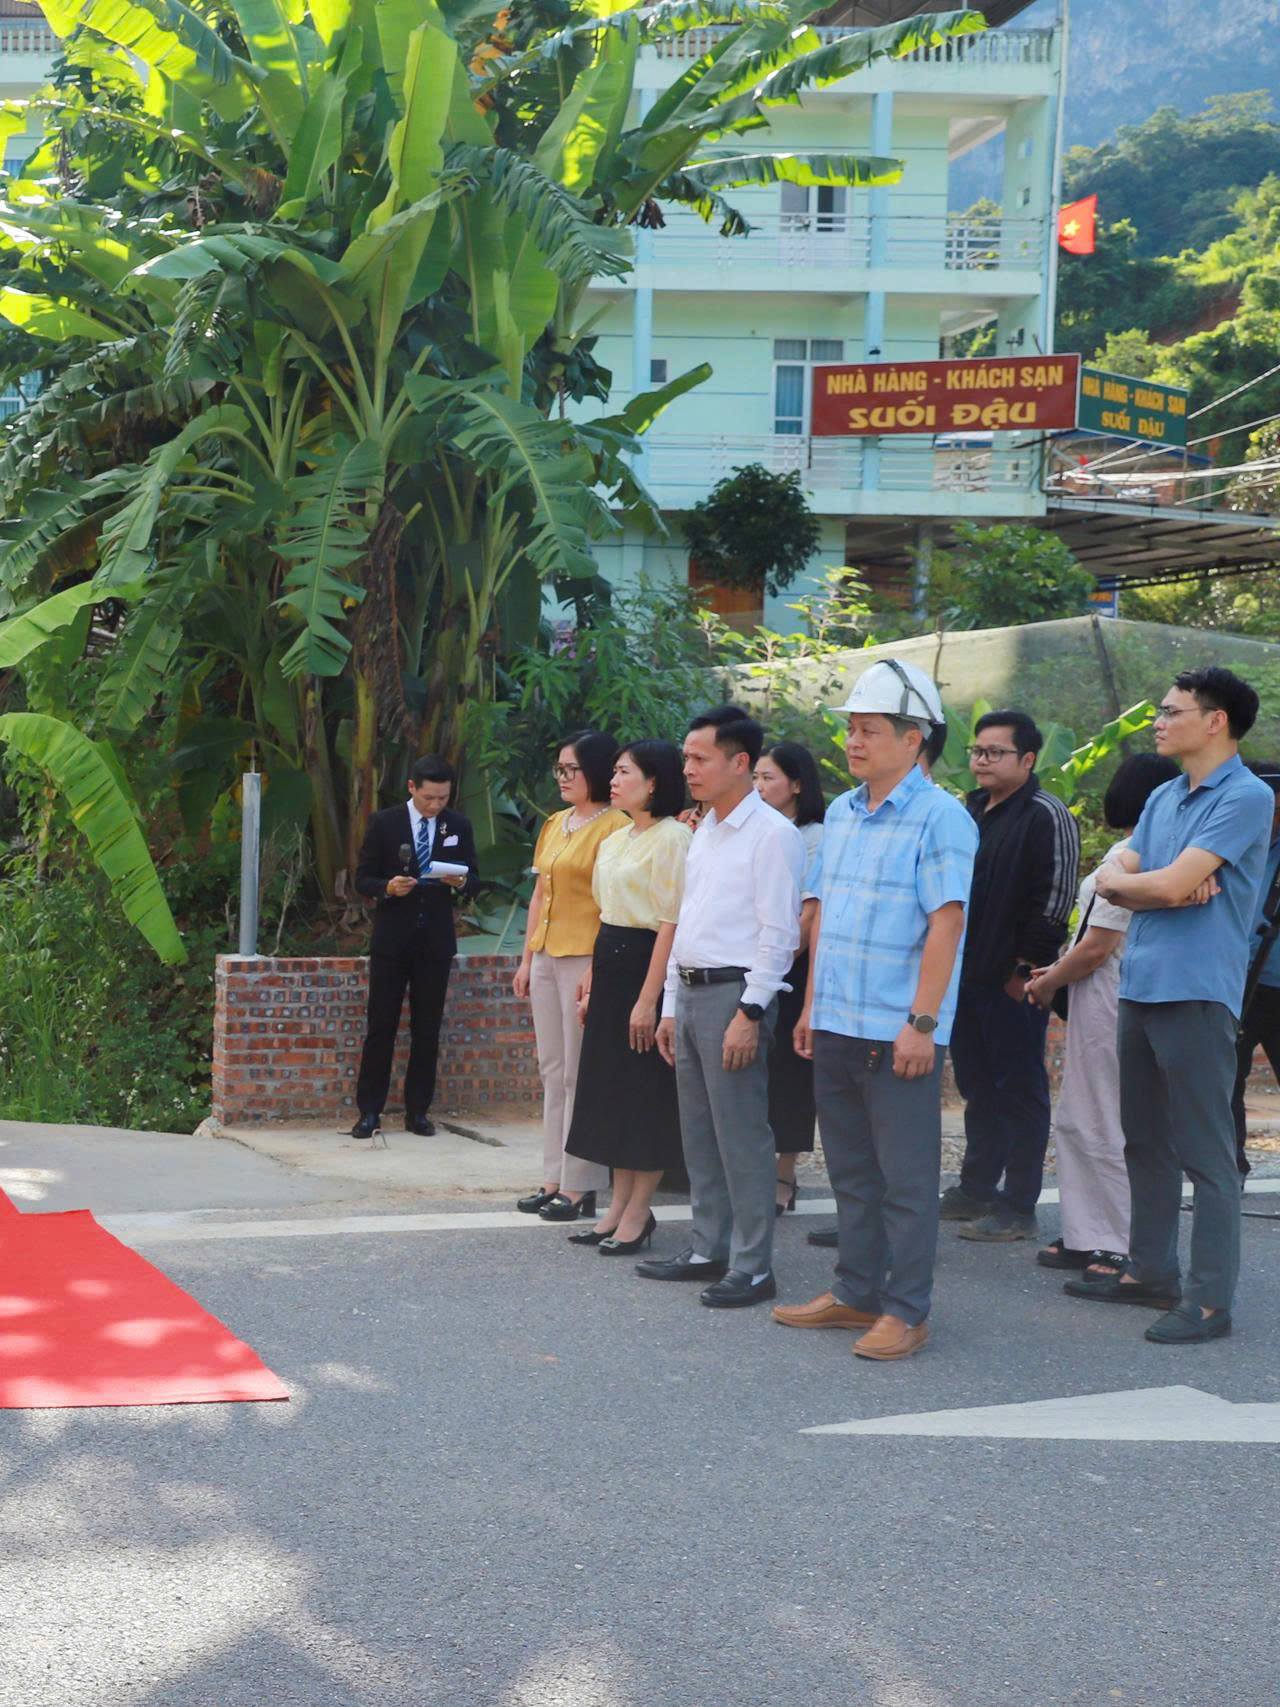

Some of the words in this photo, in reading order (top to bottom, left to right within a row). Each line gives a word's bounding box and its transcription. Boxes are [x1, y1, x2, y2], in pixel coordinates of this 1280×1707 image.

[827, 368, 868, 395] NHÀ
[873, 367, 927, 393] HÀNG
[946, 363, 1015, 391] KHÁCH
[1020, 365, 1064, 392] SẠN
[848, 395, 937, 429] SUỐI
[950, 397, 1037, 430] ĐẬU
